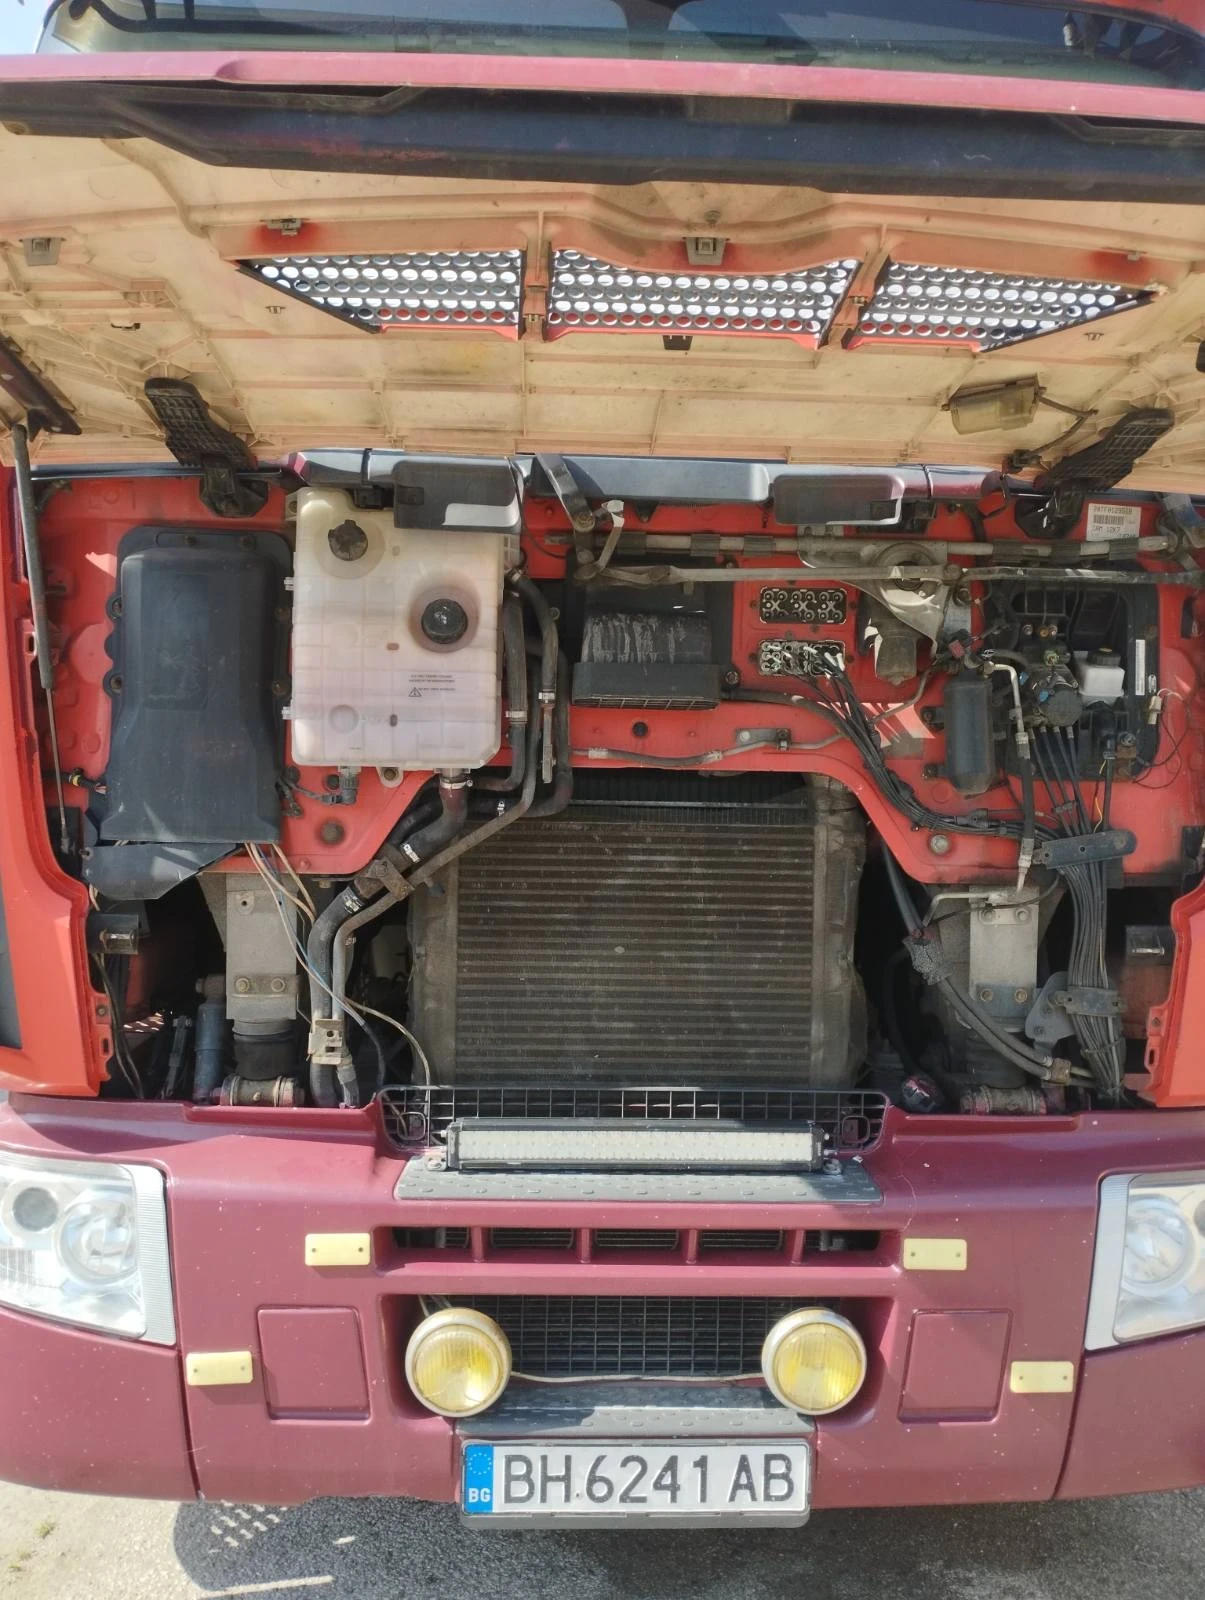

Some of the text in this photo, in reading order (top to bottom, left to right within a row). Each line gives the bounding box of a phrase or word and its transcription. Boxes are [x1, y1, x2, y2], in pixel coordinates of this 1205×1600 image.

[468, 1487, 491, 1503] BG
[504, 1453, 795, 1504] BH 6241 AB
